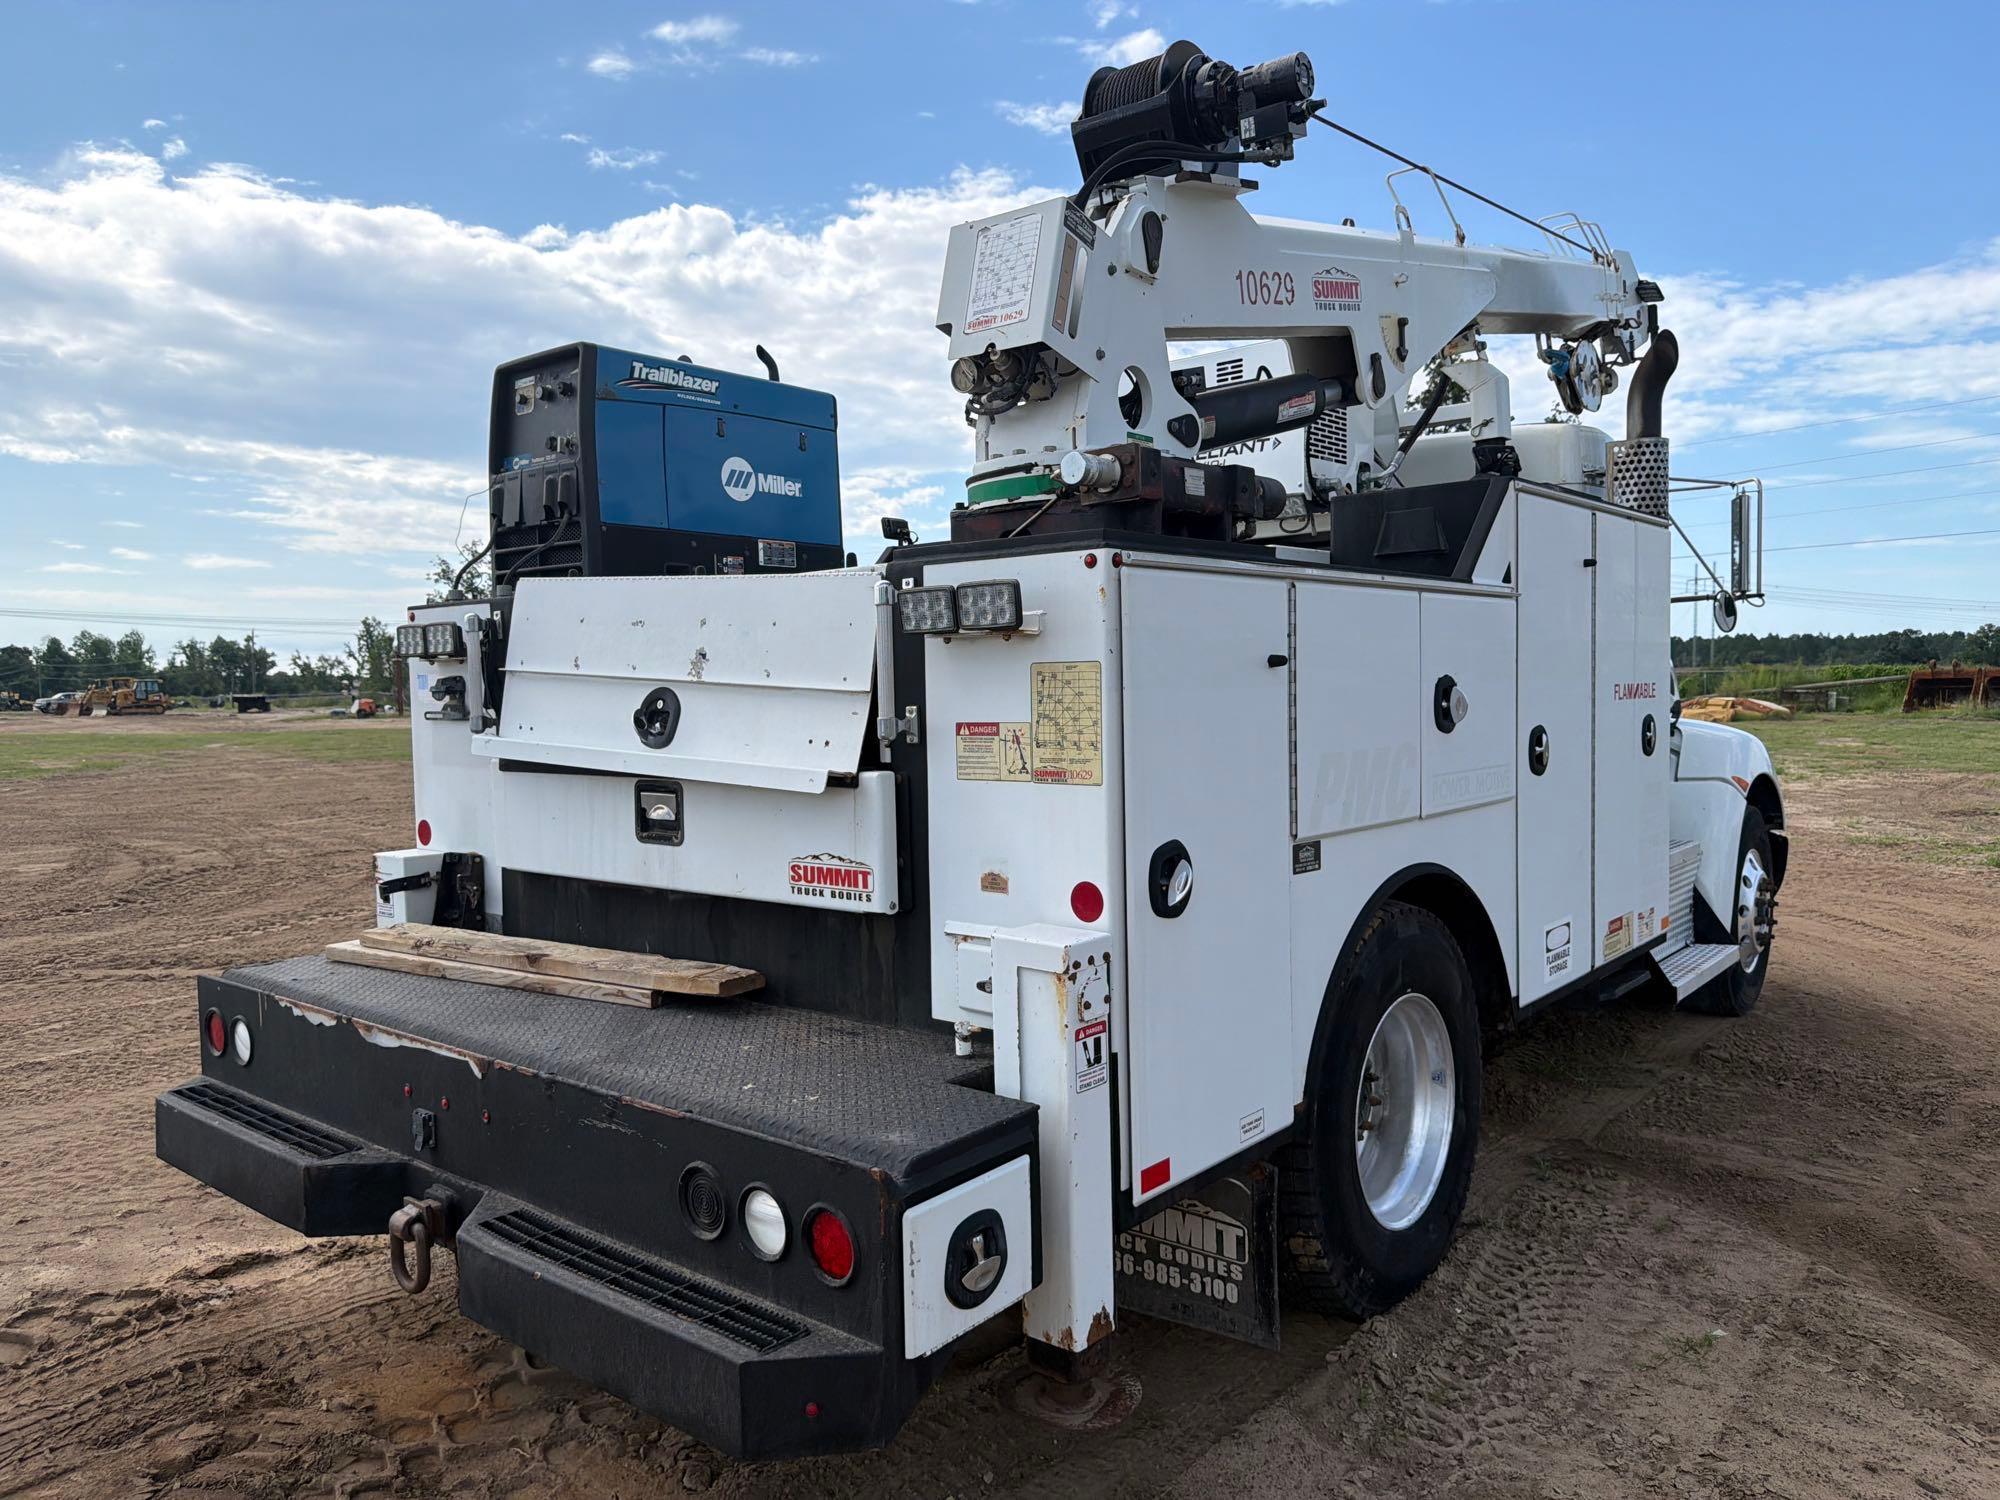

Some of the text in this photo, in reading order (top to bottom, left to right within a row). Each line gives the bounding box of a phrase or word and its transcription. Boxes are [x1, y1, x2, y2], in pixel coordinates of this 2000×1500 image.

[1235, 270, 1295, 305] 10629
[1313, 279, 1360, 300] SUMMIT
[1315, 302, 1361, 312] TRUCK BODIES
[967, 309, 1023, 330] SUMMIT 10629
[632, 361, 719, 393] Trailblazer
[757, 472, 802, 497] Miller
[969, 725, 997, 734] DANGER
[1034, 769, 1093, 780] SUMMIT 10629
[790, 863, 872, 890] SUMMIT
[790, 885, 872, 903] TRUCK BODIES
[1085, 1025, 1103, 1036] DANGER
[1159, 1243, 1243, 1281] BODIES
